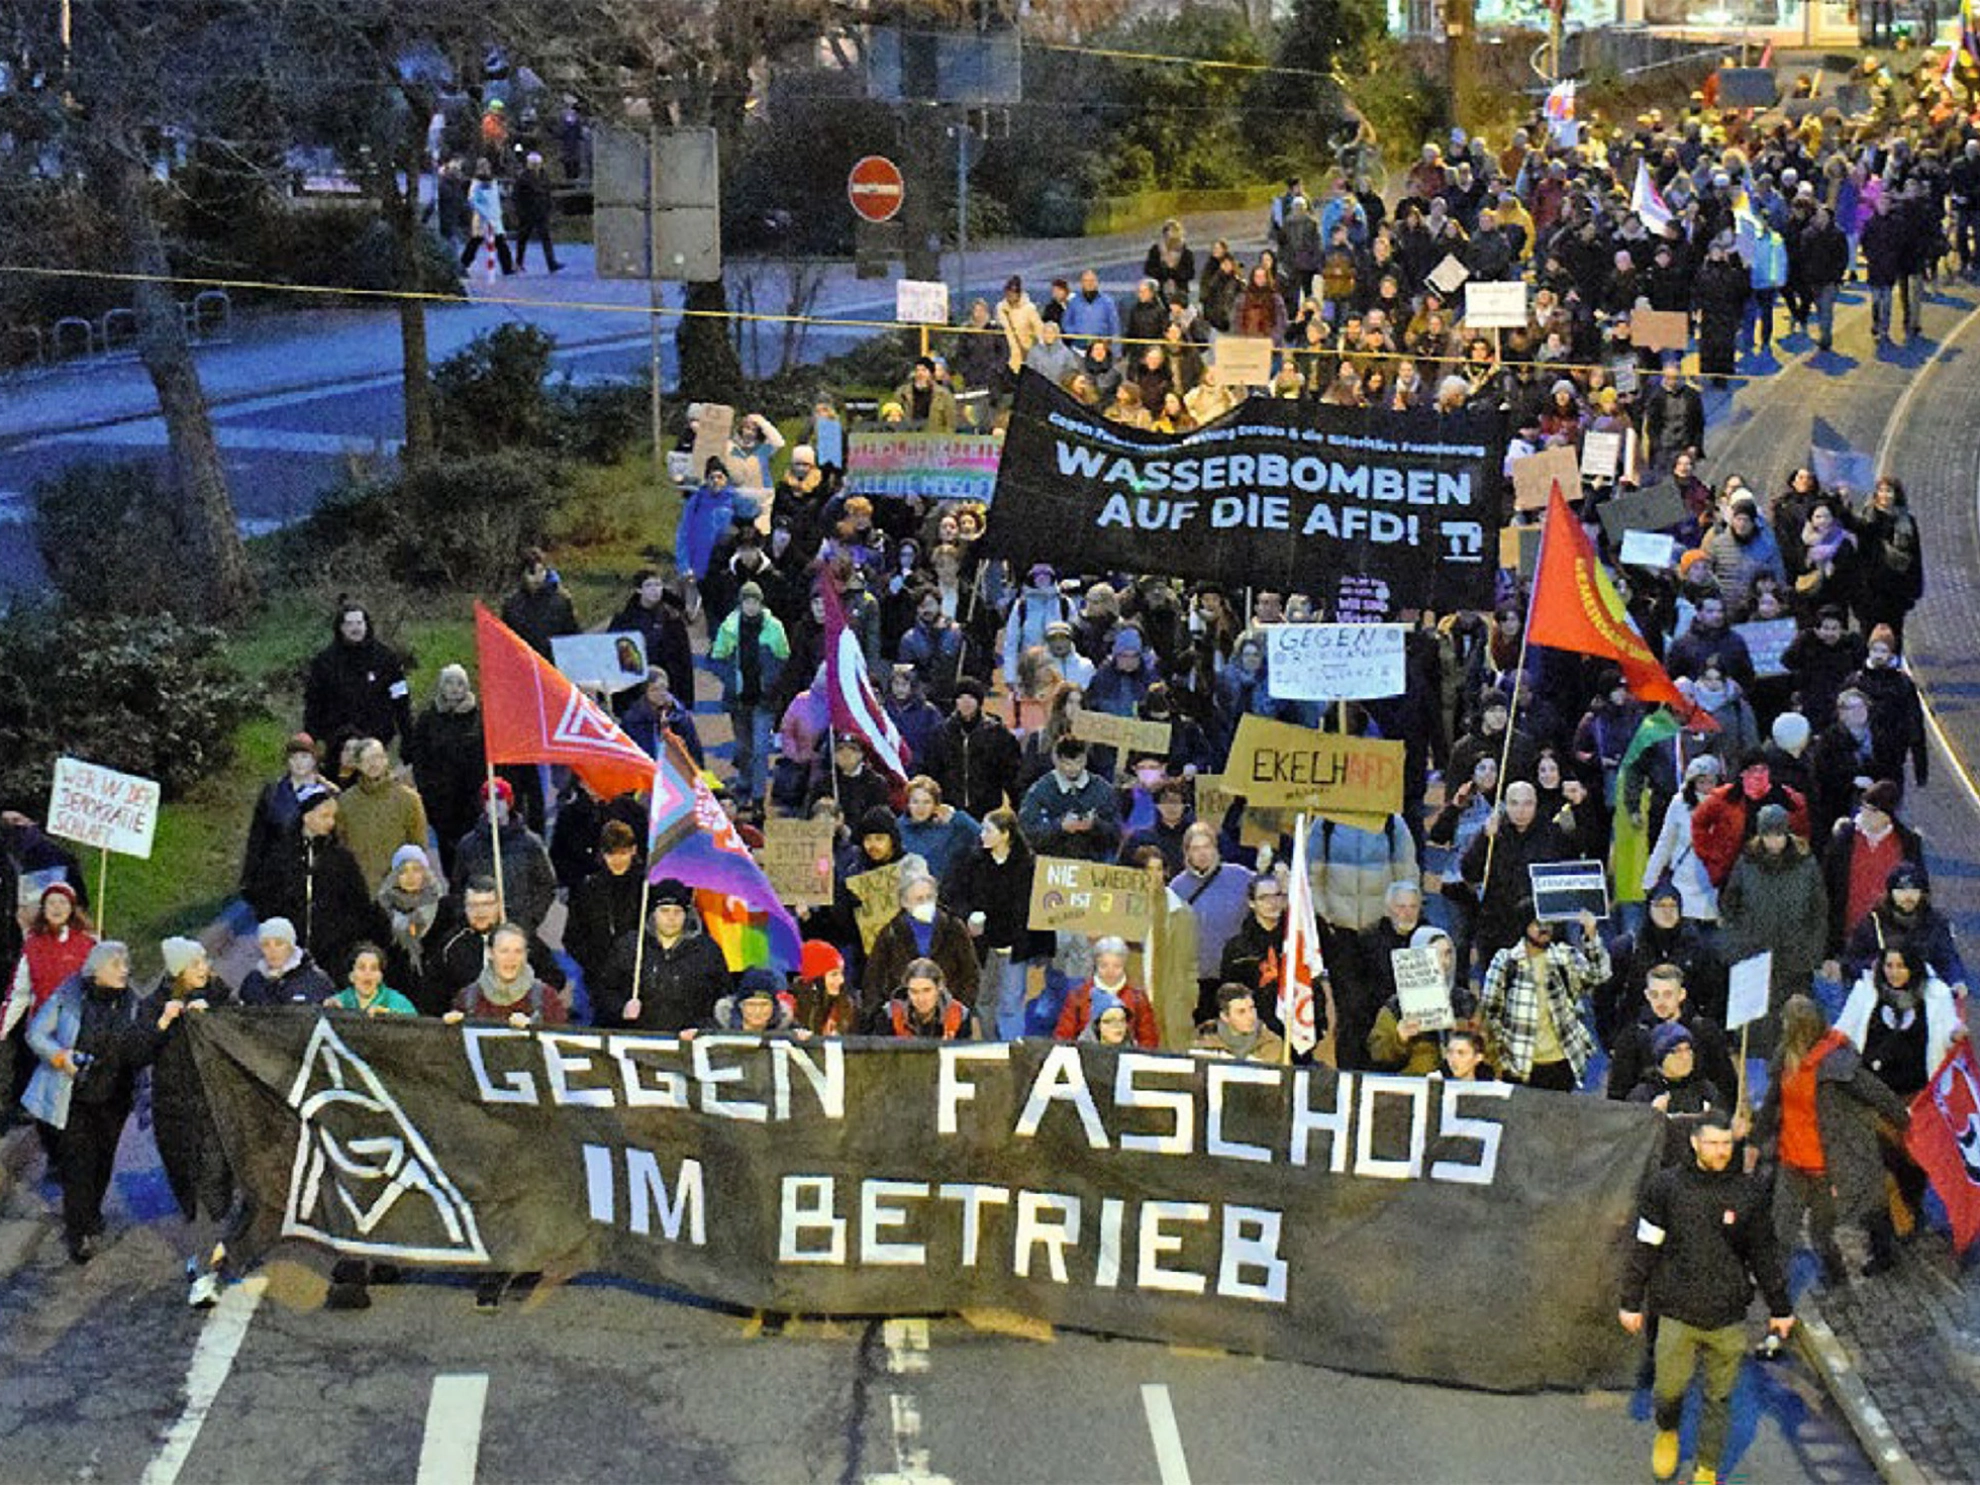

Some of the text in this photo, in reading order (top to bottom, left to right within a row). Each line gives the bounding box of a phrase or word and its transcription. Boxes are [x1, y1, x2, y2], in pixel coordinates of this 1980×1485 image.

[1055, 439, 1472, 506] WASSERBOMBEN
[1097, 492, 1420, 546] AUF DIE AFD!
[1279, 627, 1377, 651] GEGEN
[1047, 865, 1152, 891] NIE WIEDER
[461, 1027, 1515, 1186] GEGEN FASCHOS
[582, 1142, 1288, 1303] IM BETRIEB
